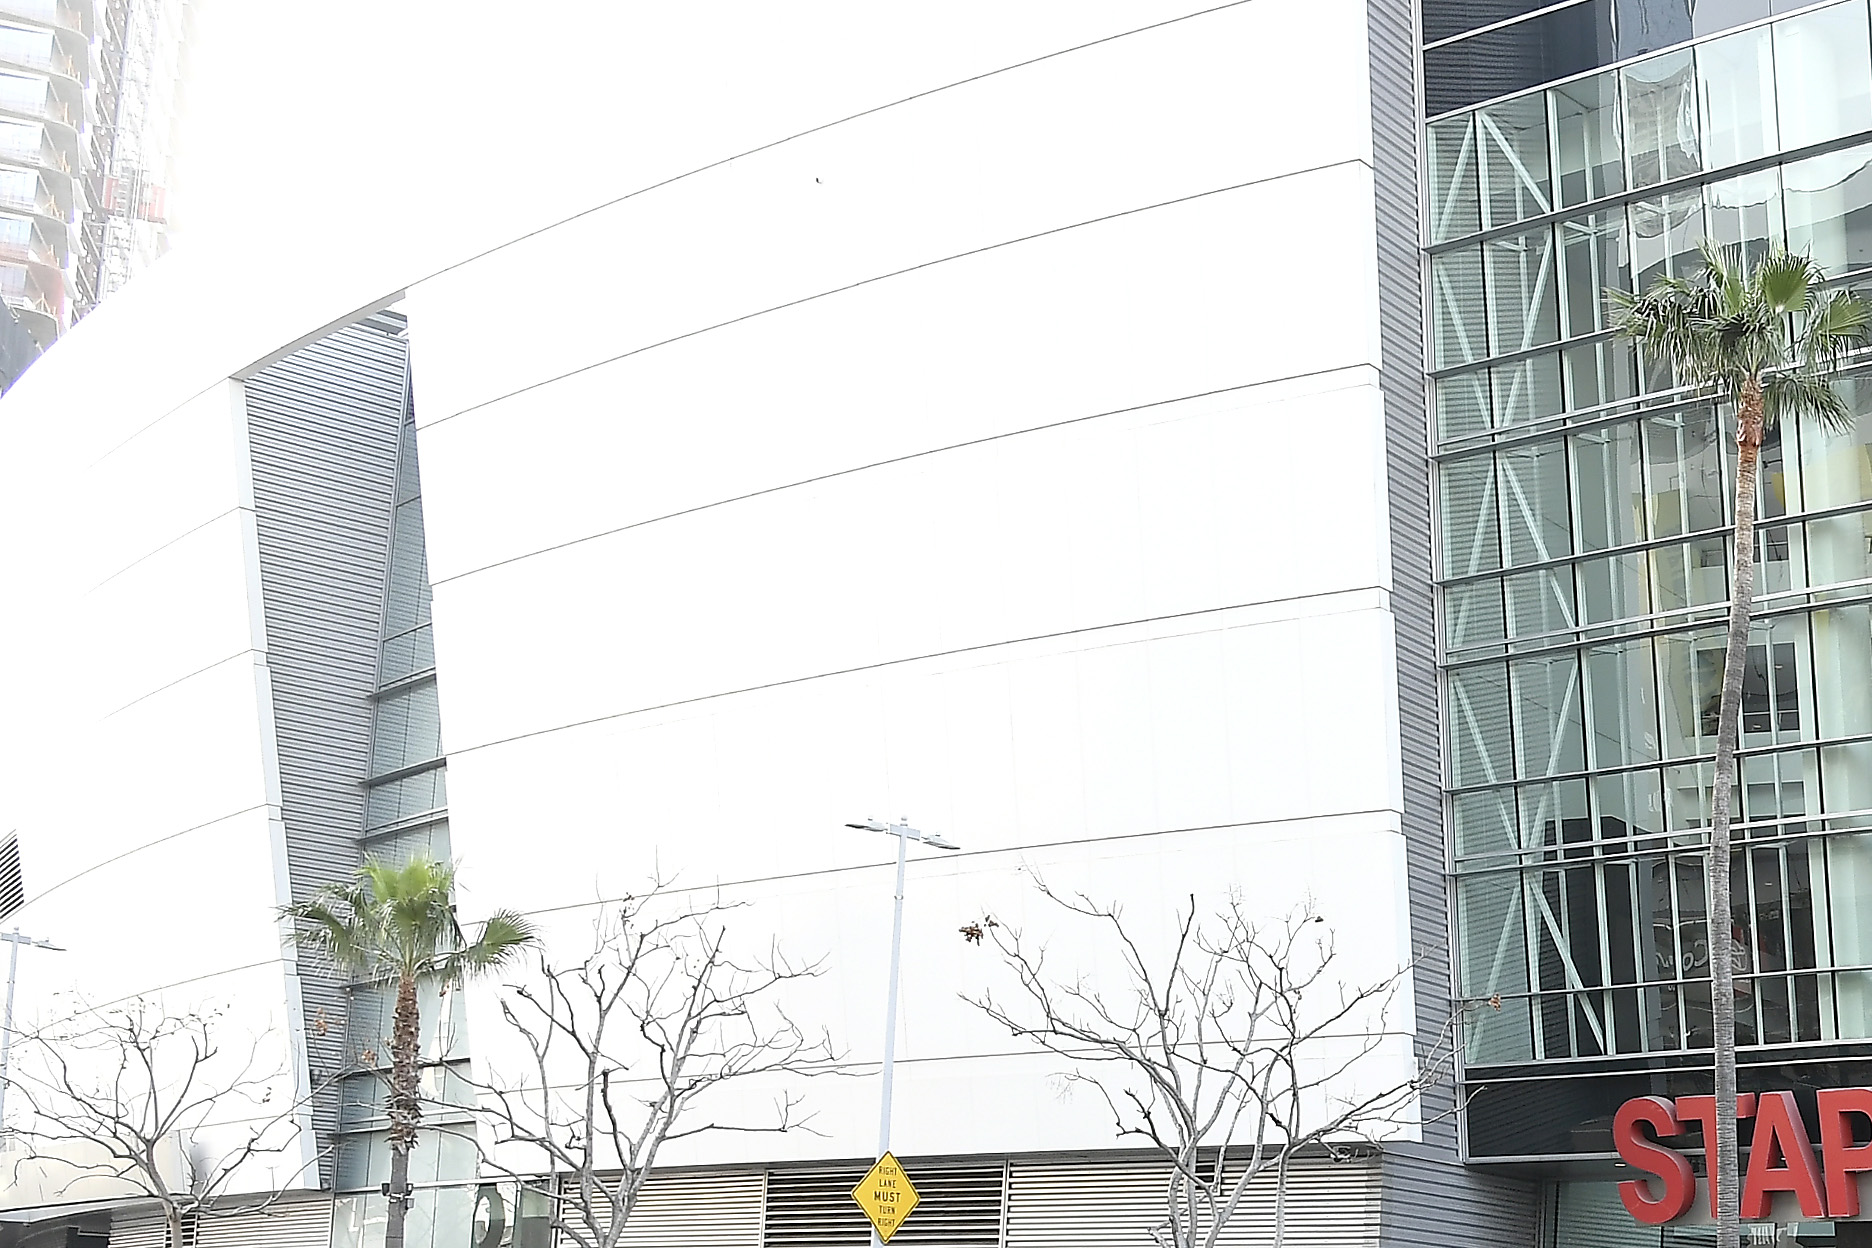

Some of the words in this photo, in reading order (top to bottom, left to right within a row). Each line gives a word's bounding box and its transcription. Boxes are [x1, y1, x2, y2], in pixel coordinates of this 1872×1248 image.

[878, 1165, 898, 1176] RIGHT
[879, 1179, 897, 1189] LANE
[874, 1190, 901, 1203] MUST
[879, 1205, 896, 1215] TURN
[877, 1217, 895, 1227] RIGHT
